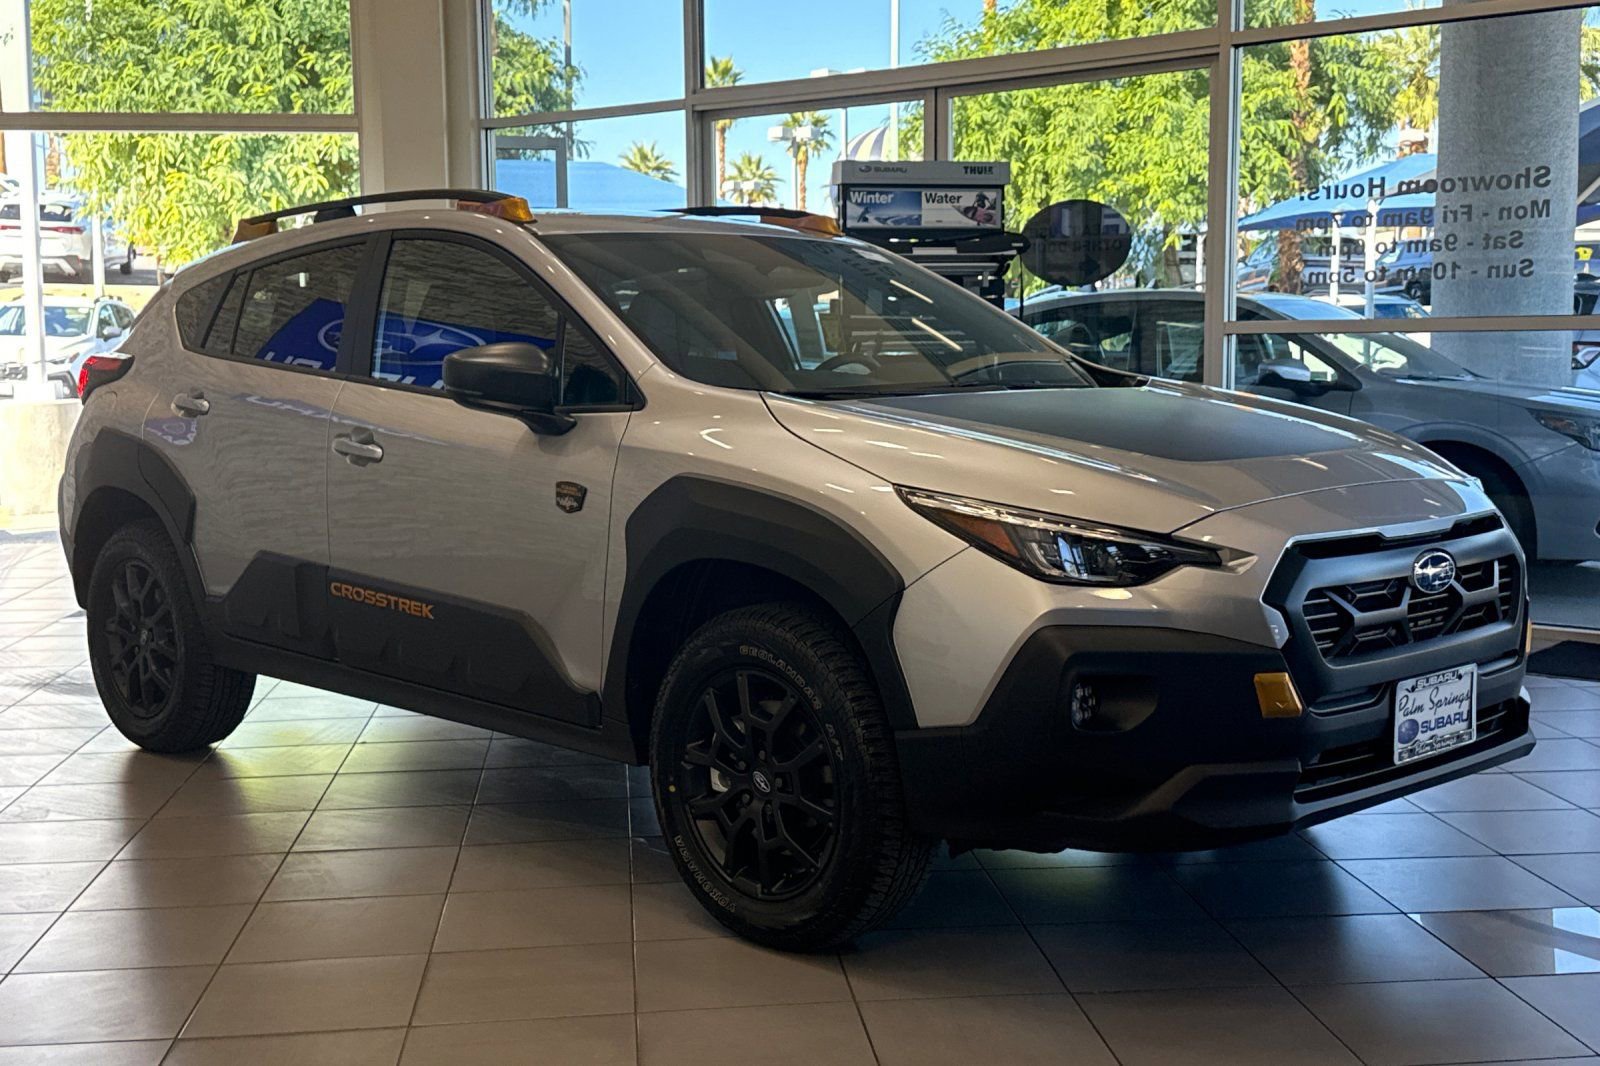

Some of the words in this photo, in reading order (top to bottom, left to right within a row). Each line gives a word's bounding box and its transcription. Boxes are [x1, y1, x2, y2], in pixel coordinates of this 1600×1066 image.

[850, 190, 894, 205] Winter
[925, 192, 963, 205] Water
[329, 581, 435, 620] CROSSTREK
[739, 645, 823, 711] GEOLANDAR
[1417, 671, 1457, 689] SUBARU
[1398, 694, 1425, 717] Palm
[1429, 686, 1471, 715] Springs
[1420, 710, 1470, 734] SUBARU
[674, 834, 737, 913] YOKOHAMA
